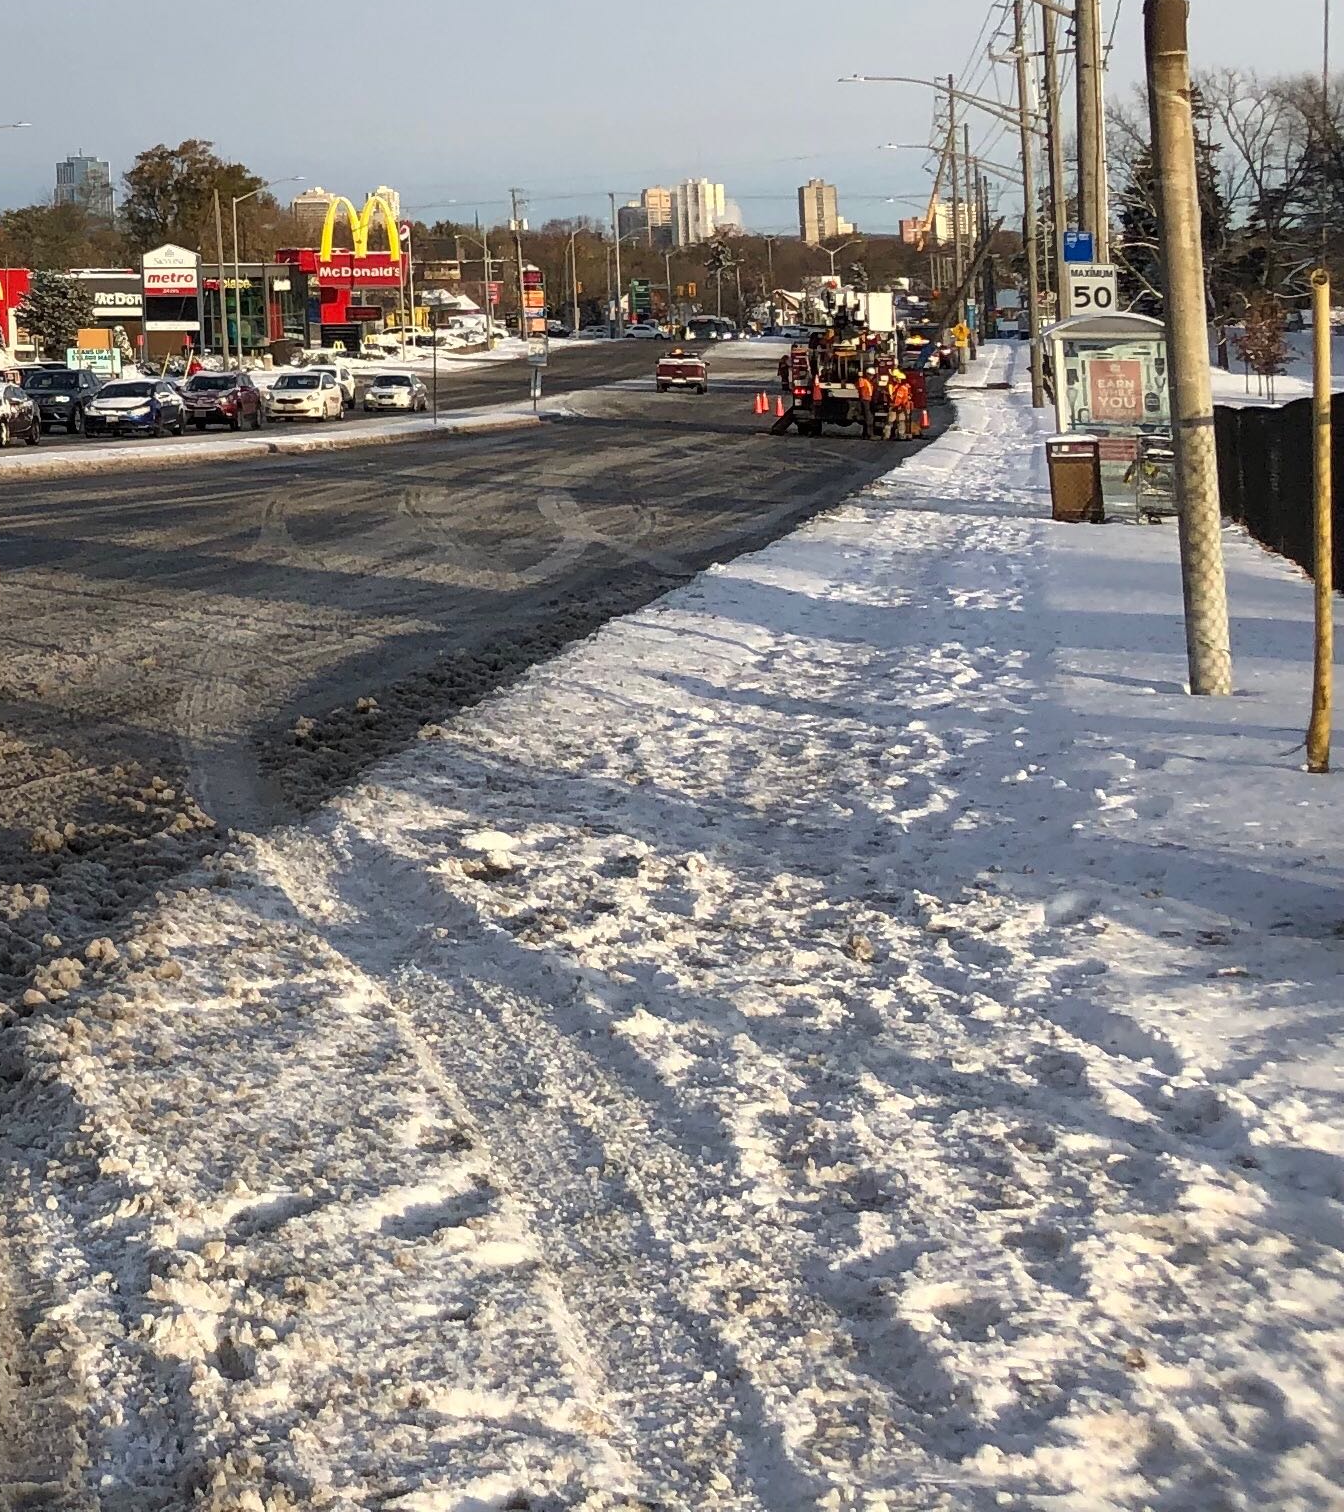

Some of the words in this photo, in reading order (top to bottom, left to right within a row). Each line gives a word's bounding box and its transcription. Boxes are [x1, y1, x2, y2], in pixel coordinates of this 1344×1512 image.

[147, 272, 194, 284] metro
[319, 266, 401, 278] McDonald's
[1070, 268, 1113, 278] MAXIMUM
[1074, 285, 1112, 308] 50
[1097, 379, 1135, 389] EARN
[1097, 395, 1137, 408] YOU
